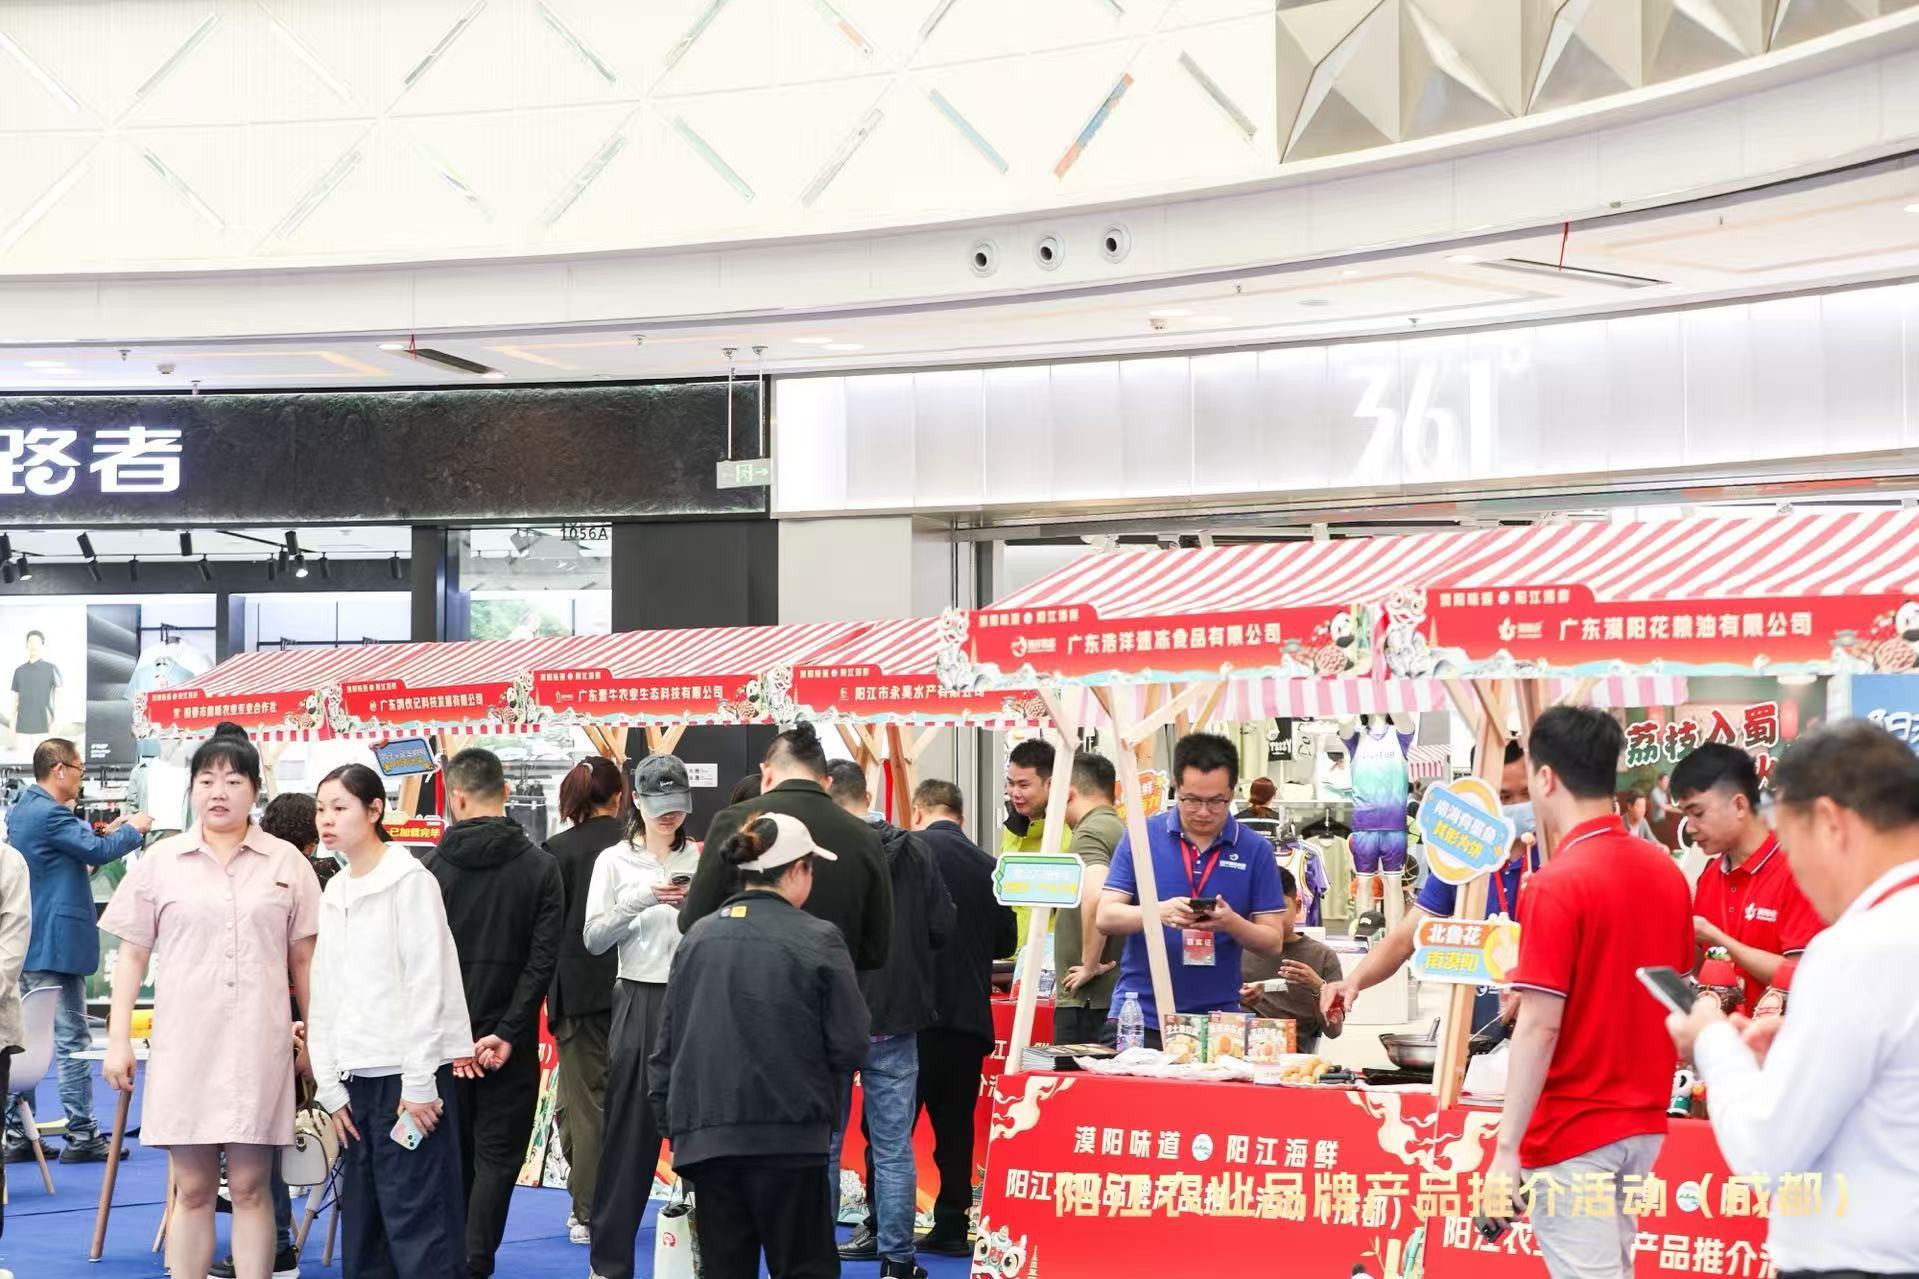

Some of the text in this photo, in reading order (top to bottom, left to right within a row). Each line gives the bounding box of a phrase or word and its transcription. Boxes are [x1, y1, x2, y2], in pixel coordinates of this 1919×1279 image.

[0, 426, 182, 496] 路者
[560, 527, 608, 541] 1056A
[1066, 622, 1282, 656] 广东浩洋速冻食品有限公司
[1558, 611, 1813, 642] 广东漠阳花粮油有限公司
[1625, 701, 1779, 768] 荔枝入蜀
[386, 827, 441, 839] 已加载完毕
[1427, 923, 1483, 946] 北鲁花
[1073, 1125, 1340, 1170] 漠阳味道 阳江海鲜
